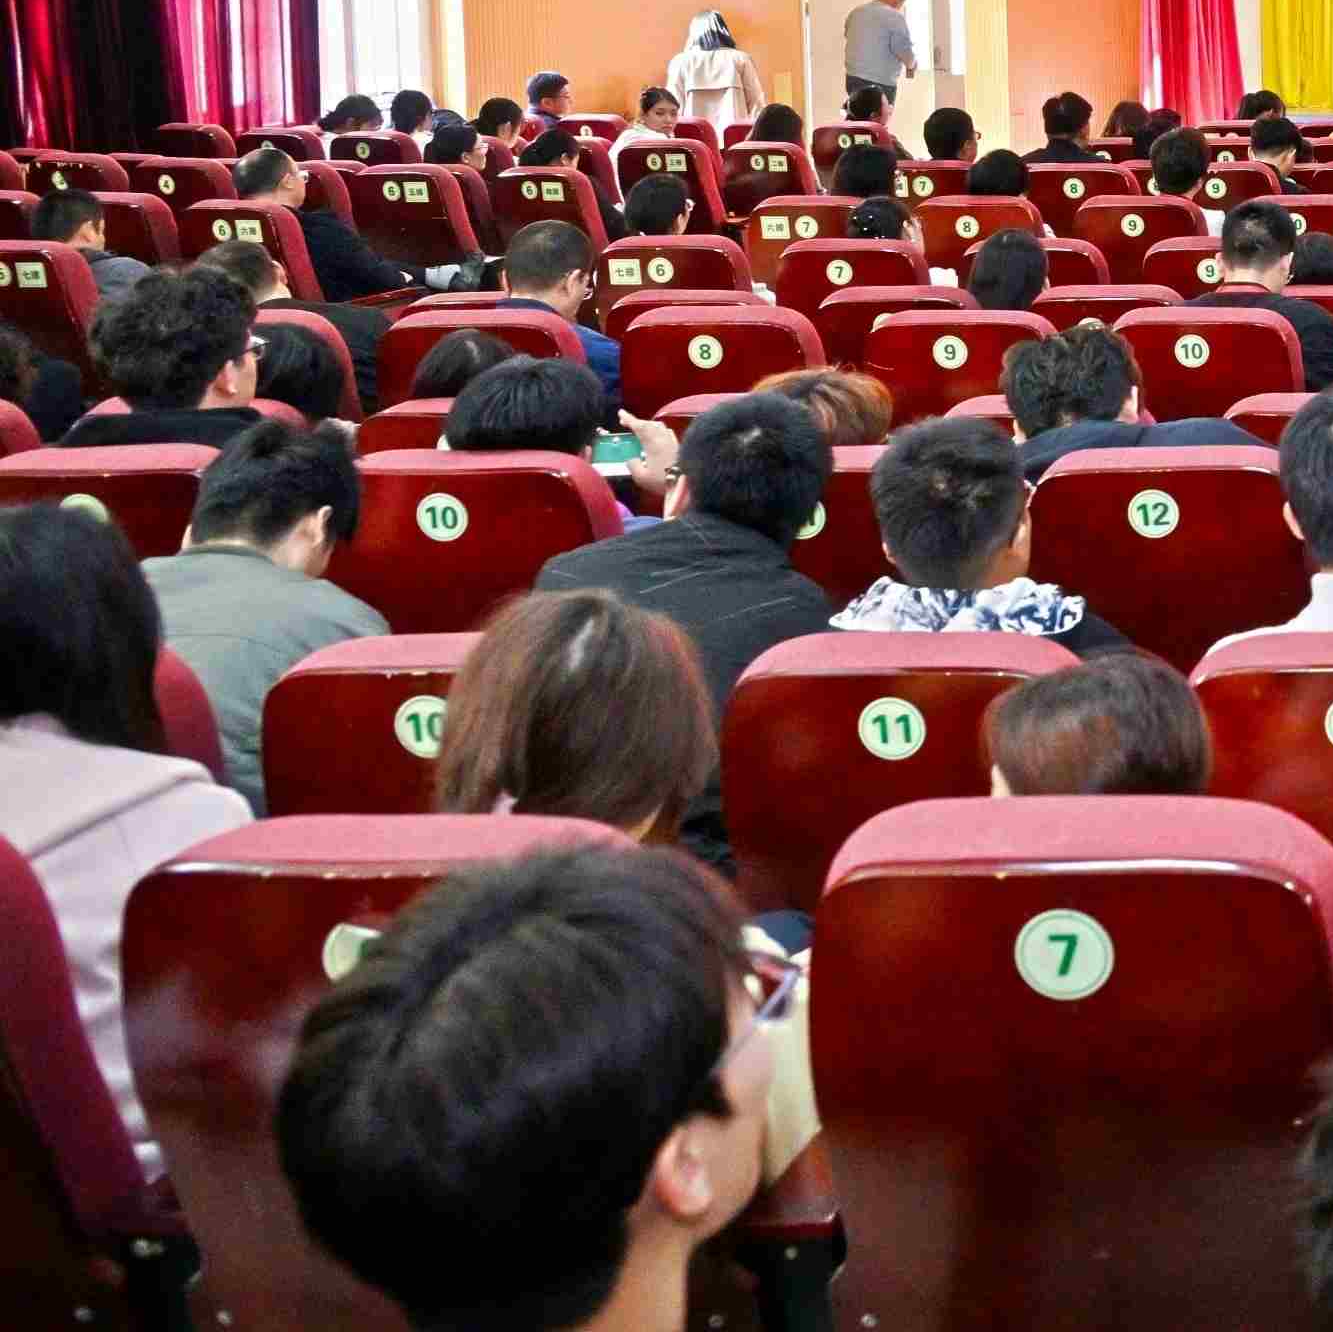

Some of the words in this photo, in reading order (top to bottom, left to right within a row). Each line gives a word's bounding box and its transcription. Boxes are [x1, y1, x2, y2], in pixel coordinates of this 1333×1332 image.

[526, 185, 533, 195] 6
[919, 180, 927, 191] 7
[1070, 183, 1078, 194] 8
[1212, 183, 1220, 194] 9
[218, 224, 226, 236] 6
[802, 221, 810, 233] 7
[962, 221, 972, 233] 8
[1128, 220, 1137, 232] 9
[655, 264, 666, 277] 6
[834, 266, 844, 279] 7
[1205, 264, 1216, 278] 9
[699, 344, 712, 360] 8
[944, 344, 956, 361] 9
[1180, 343, 1203, 360] 10
[425, 506, 458, 530] 10
[1136, 502, 1170, 526] 12
[872, 714, 912, 744] 11
[1048, 933, 1078, 976] 7
